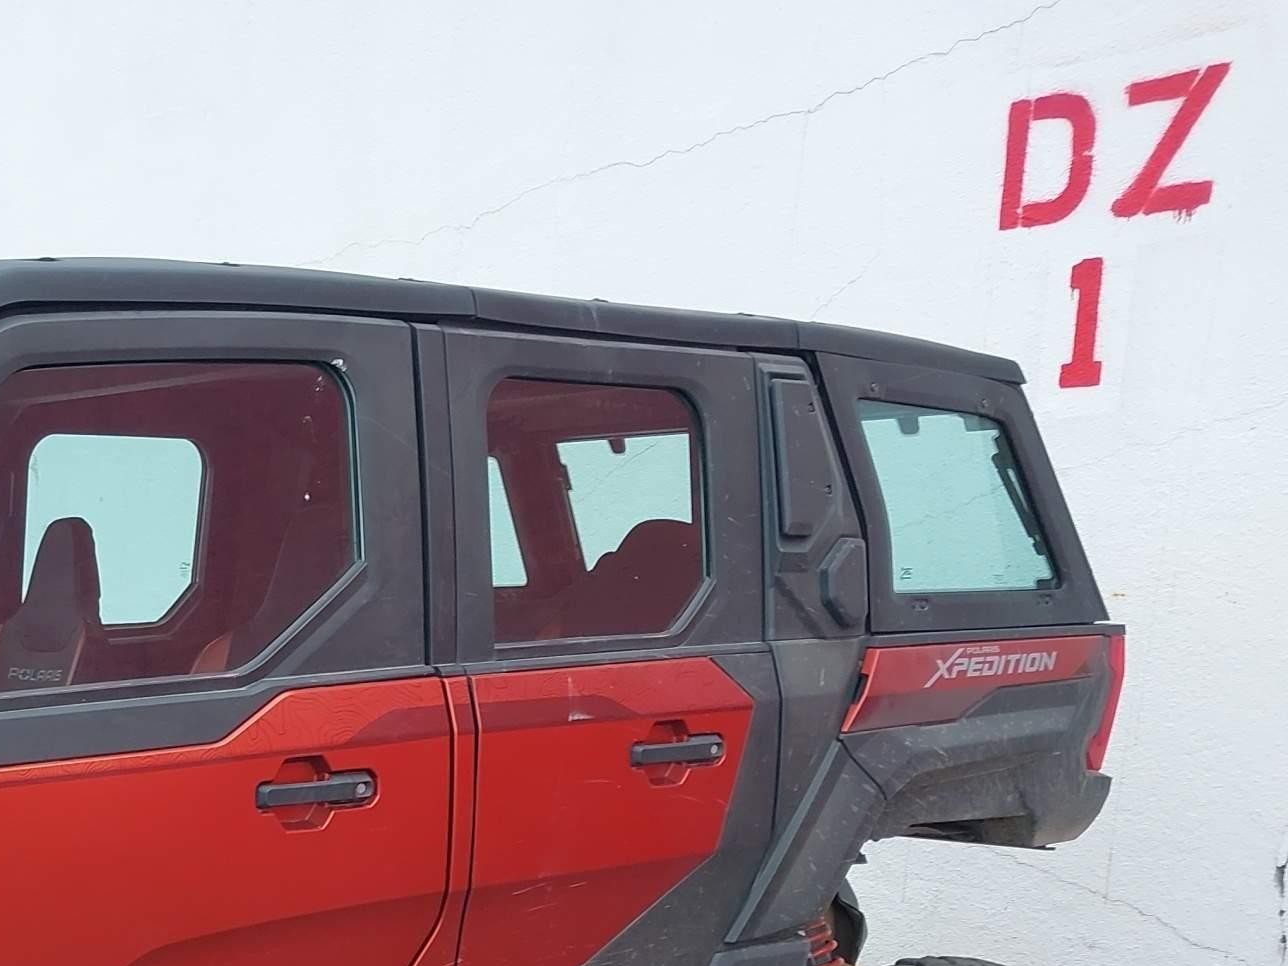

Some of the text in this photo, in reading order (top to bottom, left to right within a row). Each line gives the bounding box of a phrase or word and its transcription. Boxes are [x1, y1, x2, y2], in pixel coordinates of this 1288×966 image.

[999, 61, 1231, 230] DZ
[1059, 256, 1103, 388] 1
[923, 648, 1057, 688] XPEDITION
